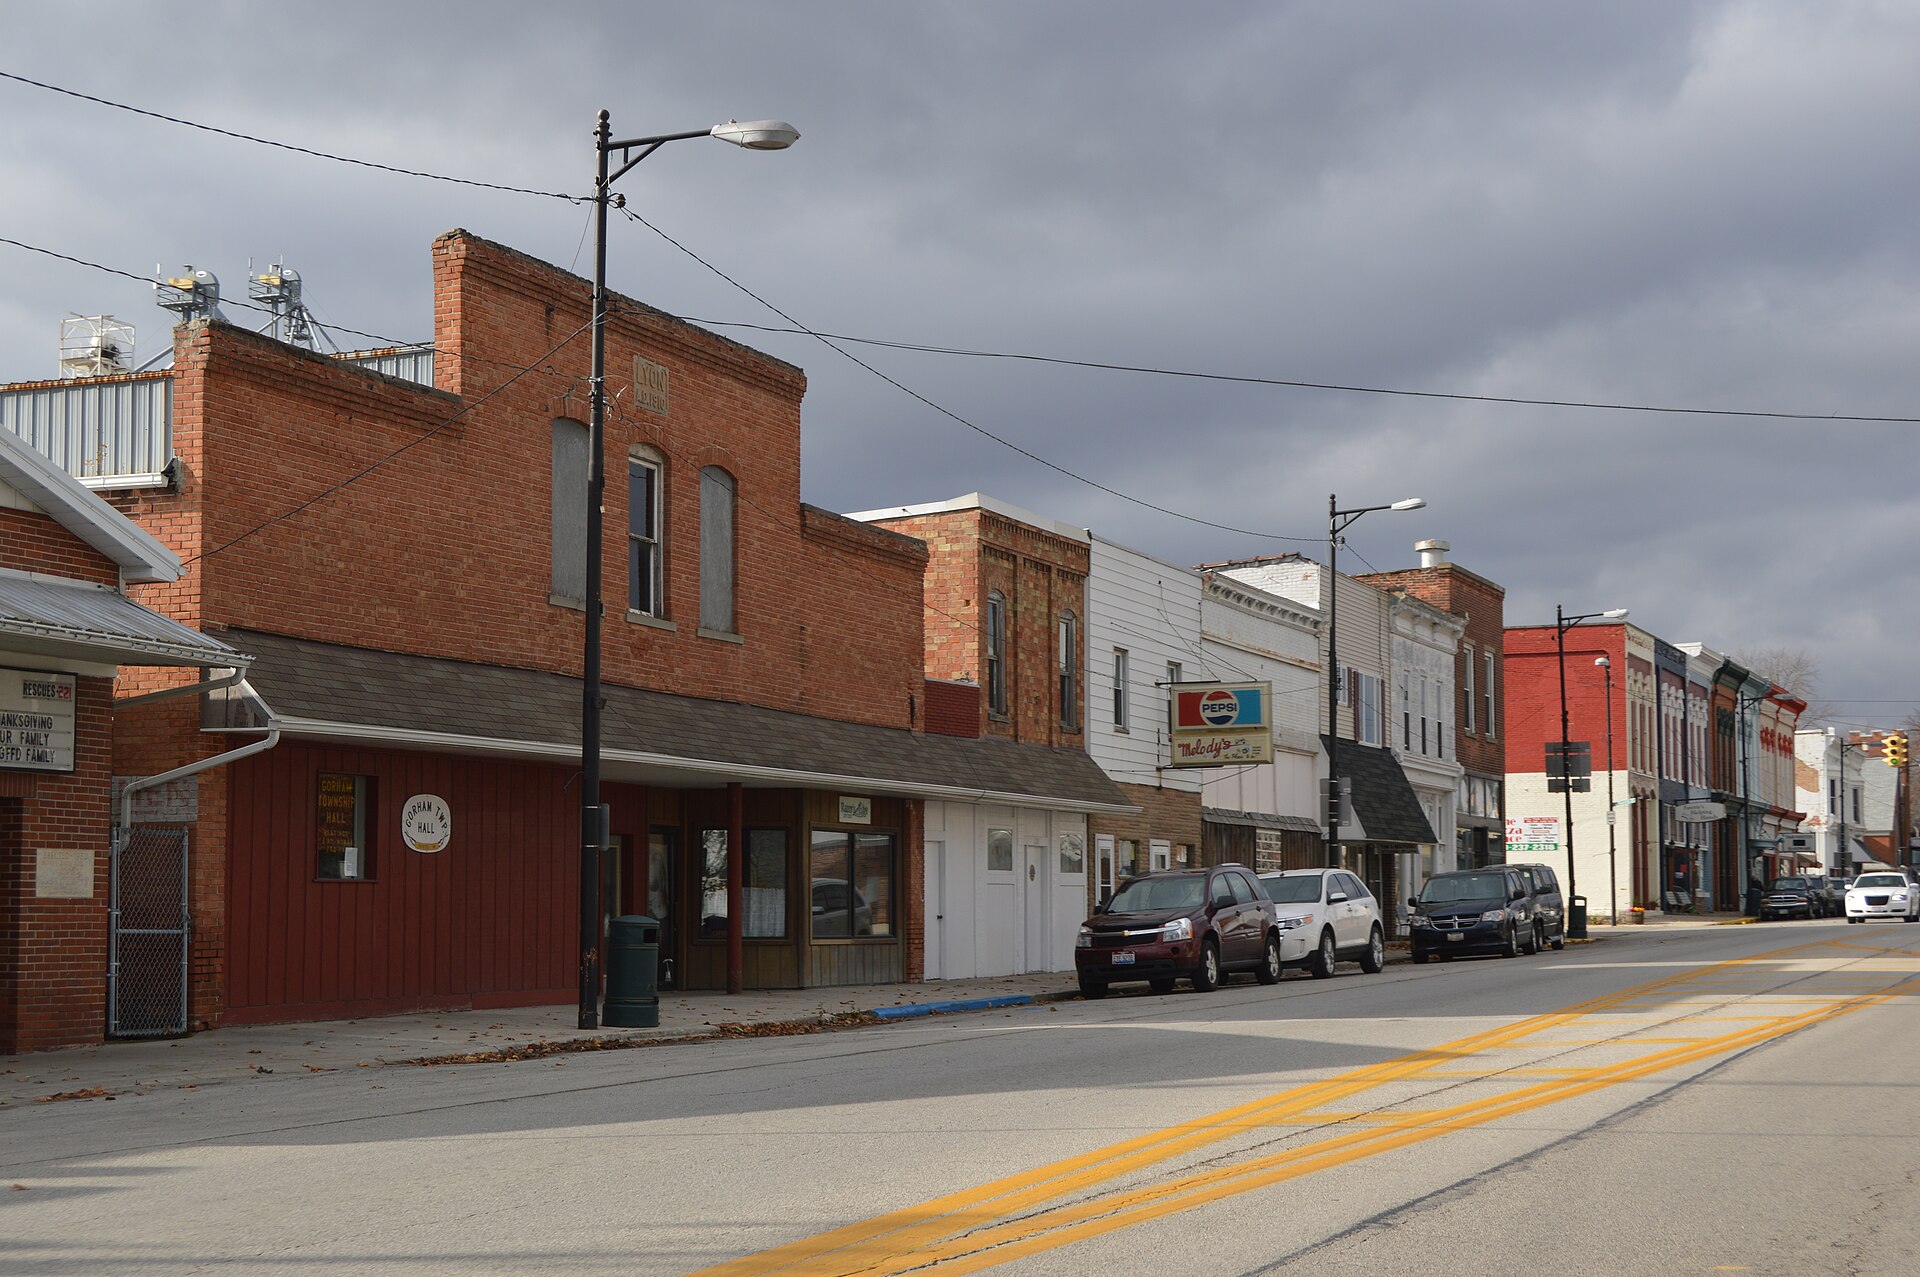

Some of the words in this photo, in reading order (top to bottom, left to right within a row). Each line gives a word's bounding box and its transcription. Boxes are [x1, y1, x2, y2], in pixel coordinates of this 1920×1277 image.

[635, 363, 668, 392] LYON
[1202, 702, 1237, 713] PEPSI
[20, 732, 50, 747] FAMILY
[26, 748, 56, 763] FAMILY
[1178, 738, 1232, 759] Melody's
[321, 780, 353, 793] GORHAM
[318, 794, 357, 809] TOWNSHIP
[326, 811, 346, 824] HALL
[405, 801, 432, 828] GORHAM
[435, 806, 448, 829] TWP
[417, 821, 435, 834] HALL
